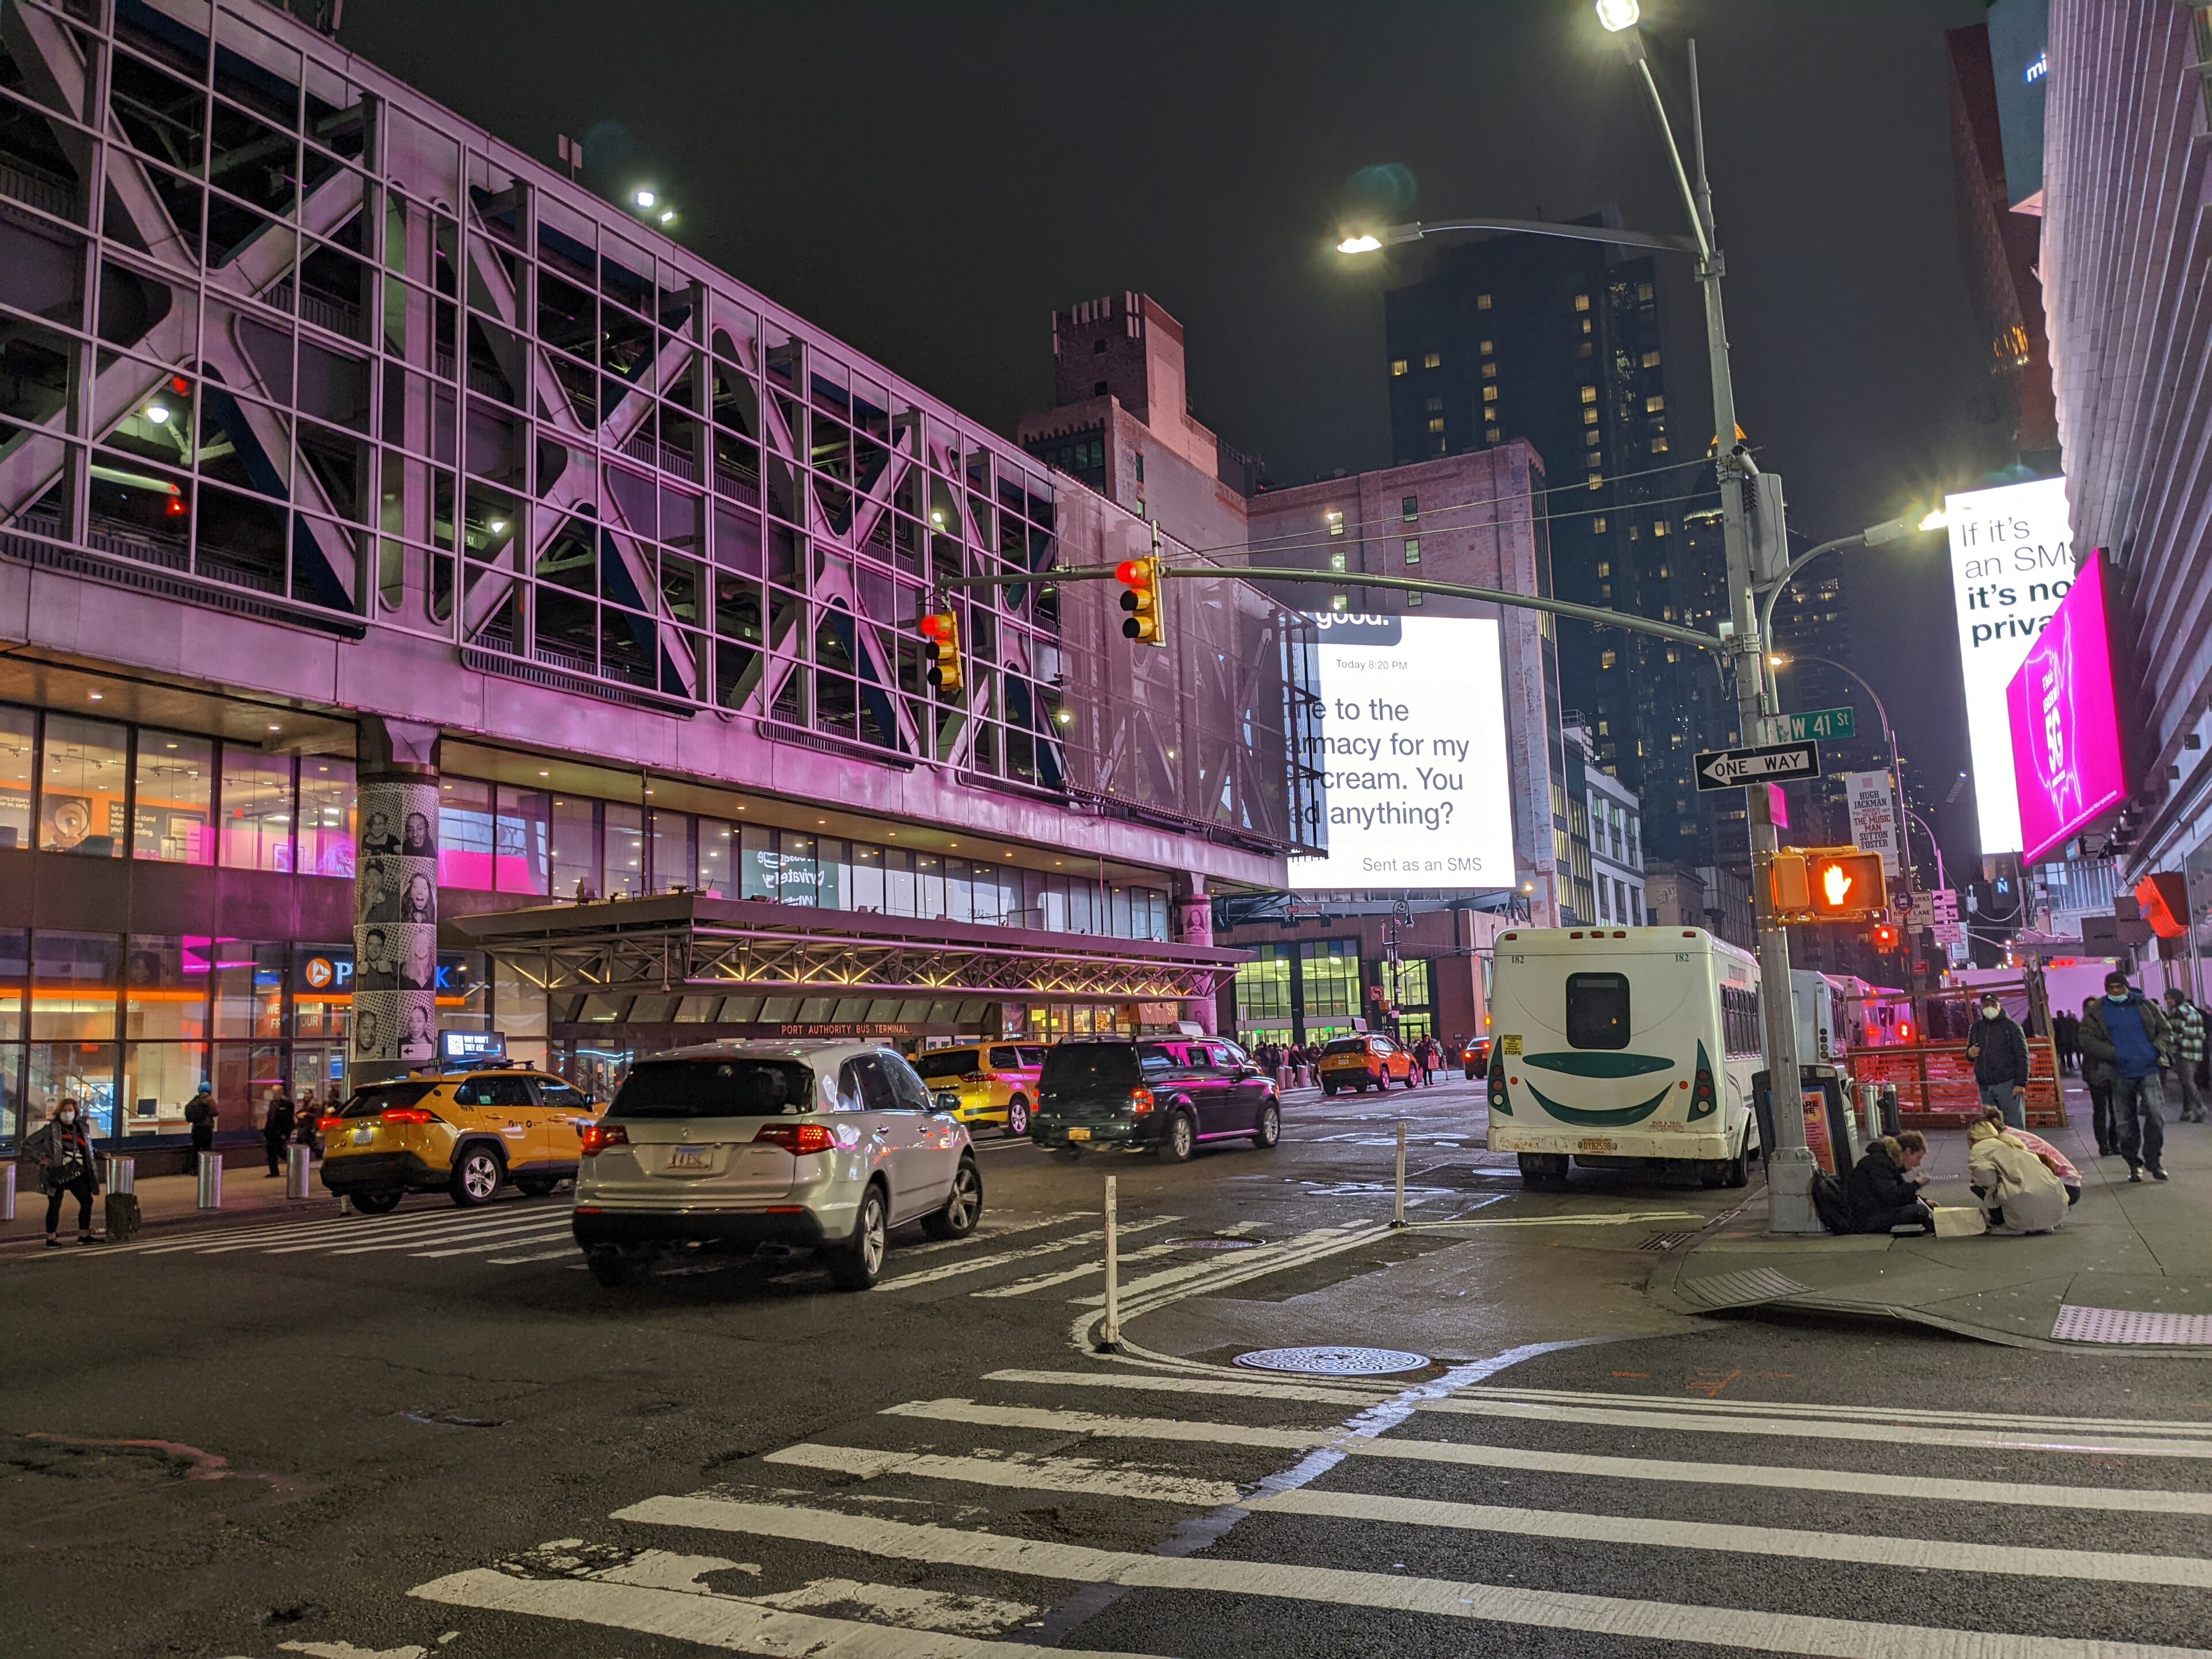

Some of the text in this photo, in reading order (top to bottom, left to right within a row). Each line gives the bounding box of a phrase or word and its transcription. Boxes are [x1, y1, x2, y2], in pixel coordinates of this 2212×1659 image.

[1961, 522, 1978, 547] If
[1965, 541, 2076, 578] an SM
[2029, 579, 2075, 602] no
[1336, 659, 1407, 671] Today 8:20 PM
[1335, 698, 1360, 720] to
[1369, 698, 1409, 721] the
[1791, 713, 1849, 739] W 41 St
[2045, 706, 2063, 774] 5G
[1389, 733, 1425, 755] for
[1433, 738, 1469, 762] my
[1715, 753, 1801, 777] ONE WAY
[1415, 767, 1463, 790] You
[1859, 790, 1880, 800] HUGH
[1854, 798, 1887, 809] JACKMAN
[1330, 801, 1453, 831] anything?
[1853, 815, 1891, 826] THE MUSIC
[1864, 823, 1881, 832] MAN
[1859, 830, 1888, 841] SUTTON
[1861, 839, 1888, 849] FOSTER
[1363, 857, 1482, 871] Sent as an SMS
[1511, 956, 1525, 964] 182
[1675, 953, 1690, 962] 182
[781, 1024, 908, 1035] PORT AUTHORITY BUS TERMINAL
[463, 1035, 474, 1044] WHY
[464, 1043, 475, 1051] THEY
